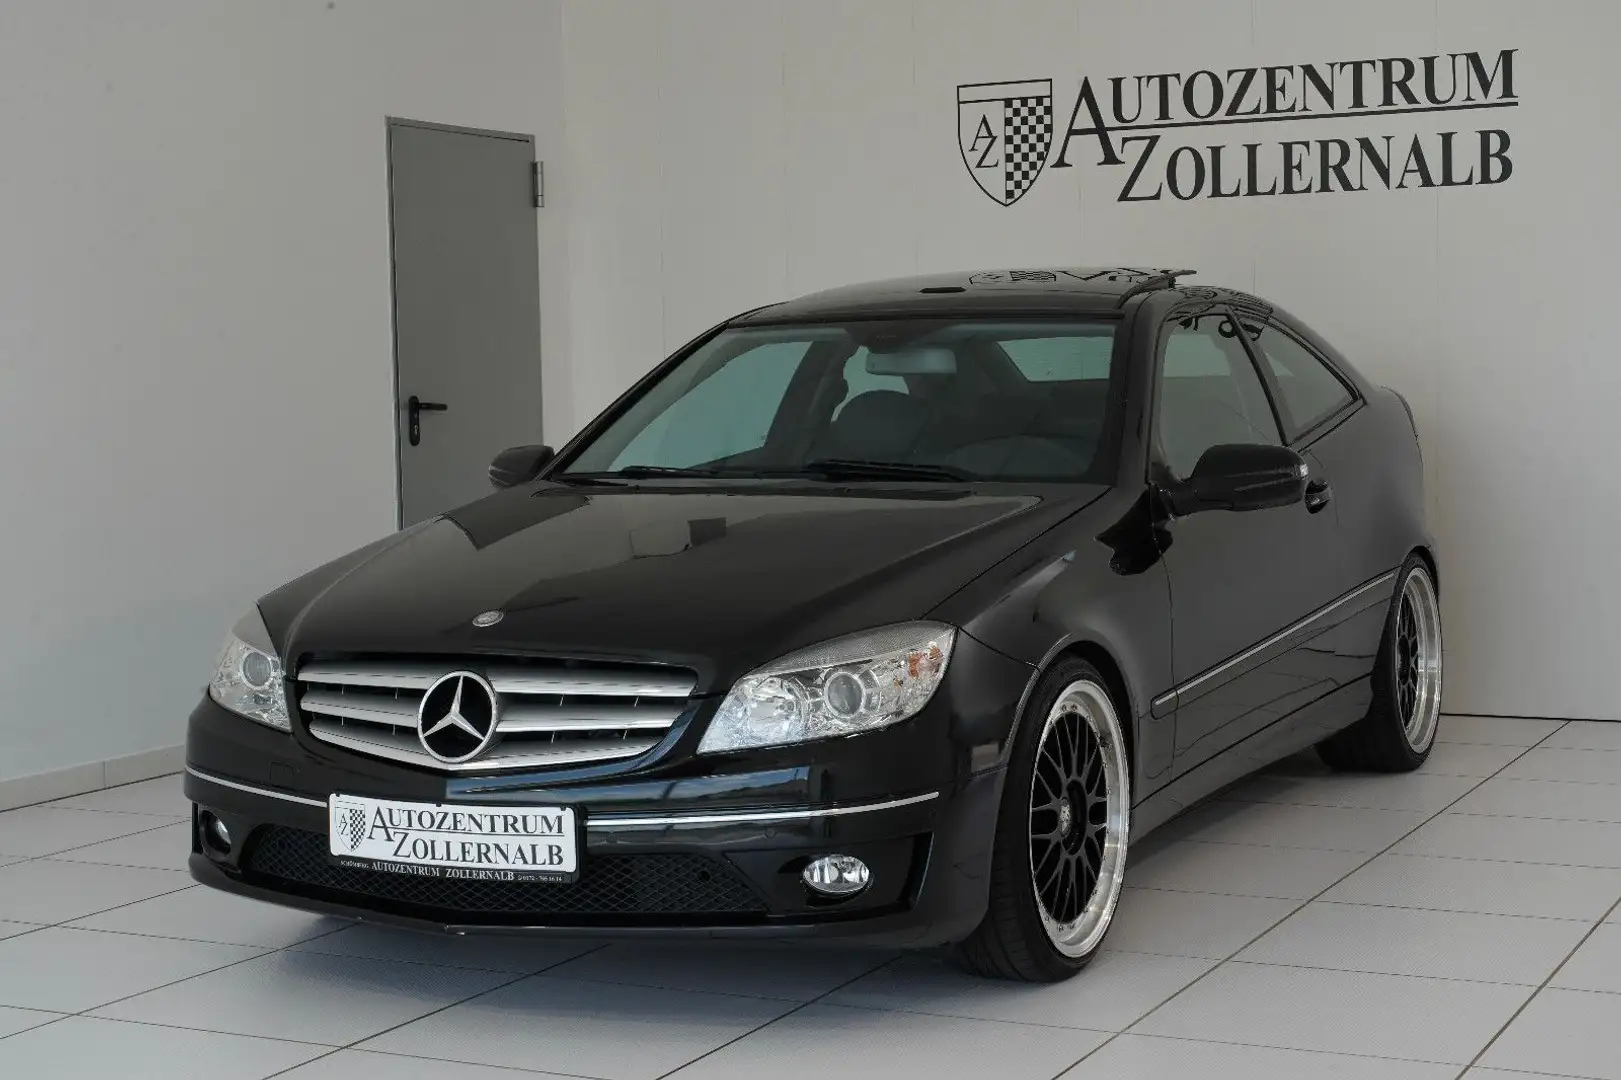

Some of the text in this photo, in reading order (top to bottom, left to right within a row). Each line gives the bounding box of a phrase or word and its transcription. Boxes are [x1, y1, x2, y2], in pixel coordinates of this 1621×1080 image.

[1050, 48, 1519, 168] AUTOZENTRUM
[1117, 128, 1513, 202] ZOLLERNALB
[367, 806, 563, 841] AUTOZENTRUM
[392, 831, 564, 866] ZOLLERNALB
[371, 861, 440, 876] AUTOZENTRUM
[445, 868, 515, 881] ZOLLERNALB
